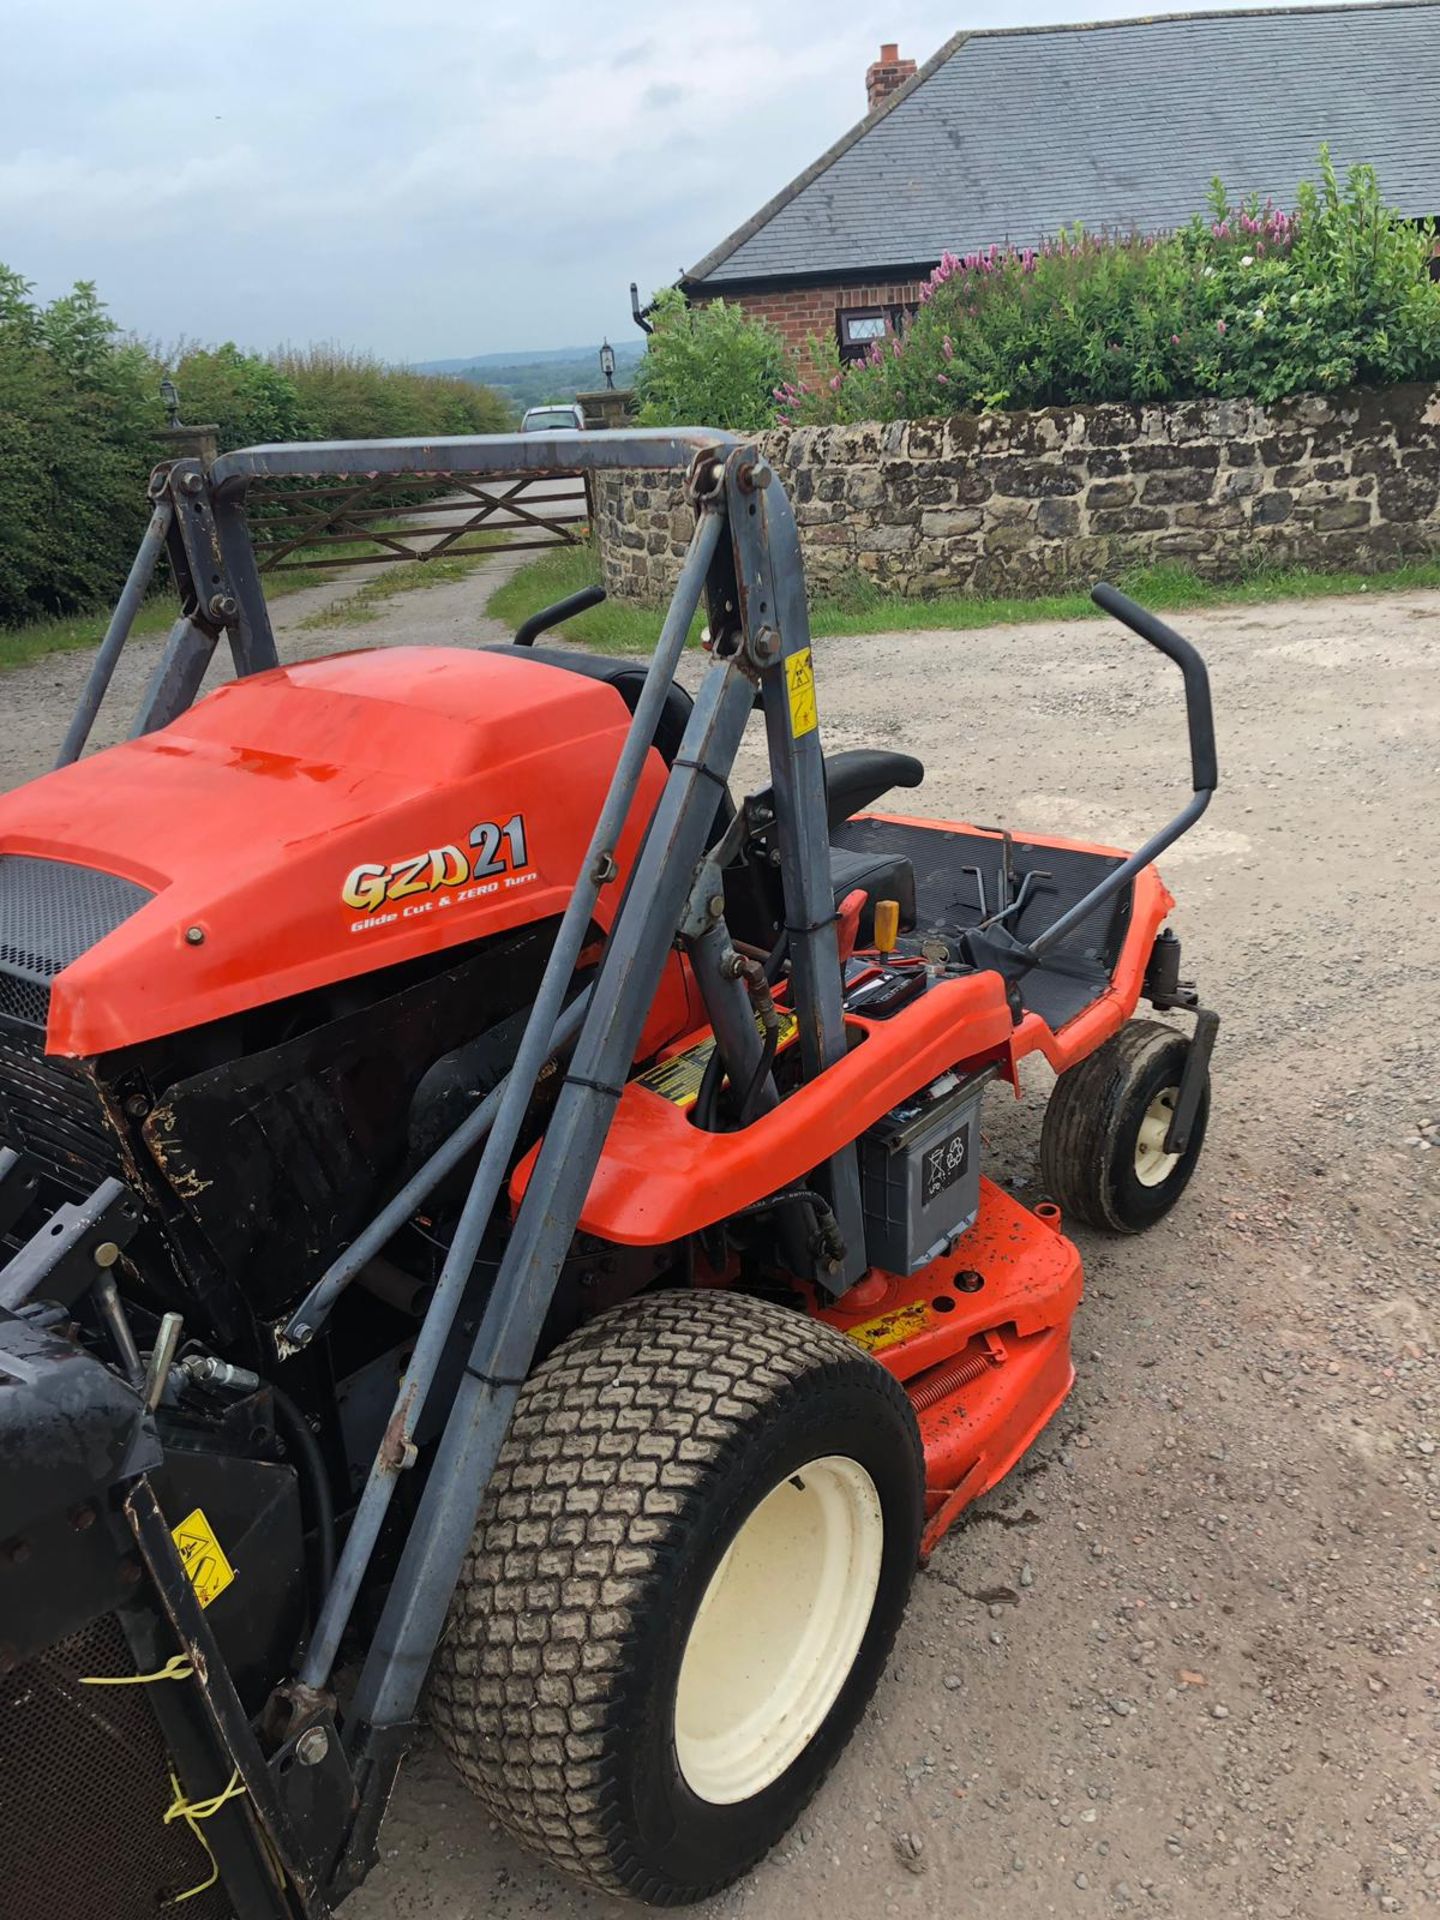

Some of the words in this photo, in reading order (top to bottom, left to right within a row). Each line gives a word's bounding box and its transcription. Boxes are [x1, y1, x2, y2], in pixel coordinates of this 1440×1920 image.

[351, 913, 398, 932] Glide
[403, 902, 433, 917] Cut
[438, 896, 451, 907] &
[457, 882, 499, 902] ZERO
[503, 873, 537, 887] Turn
